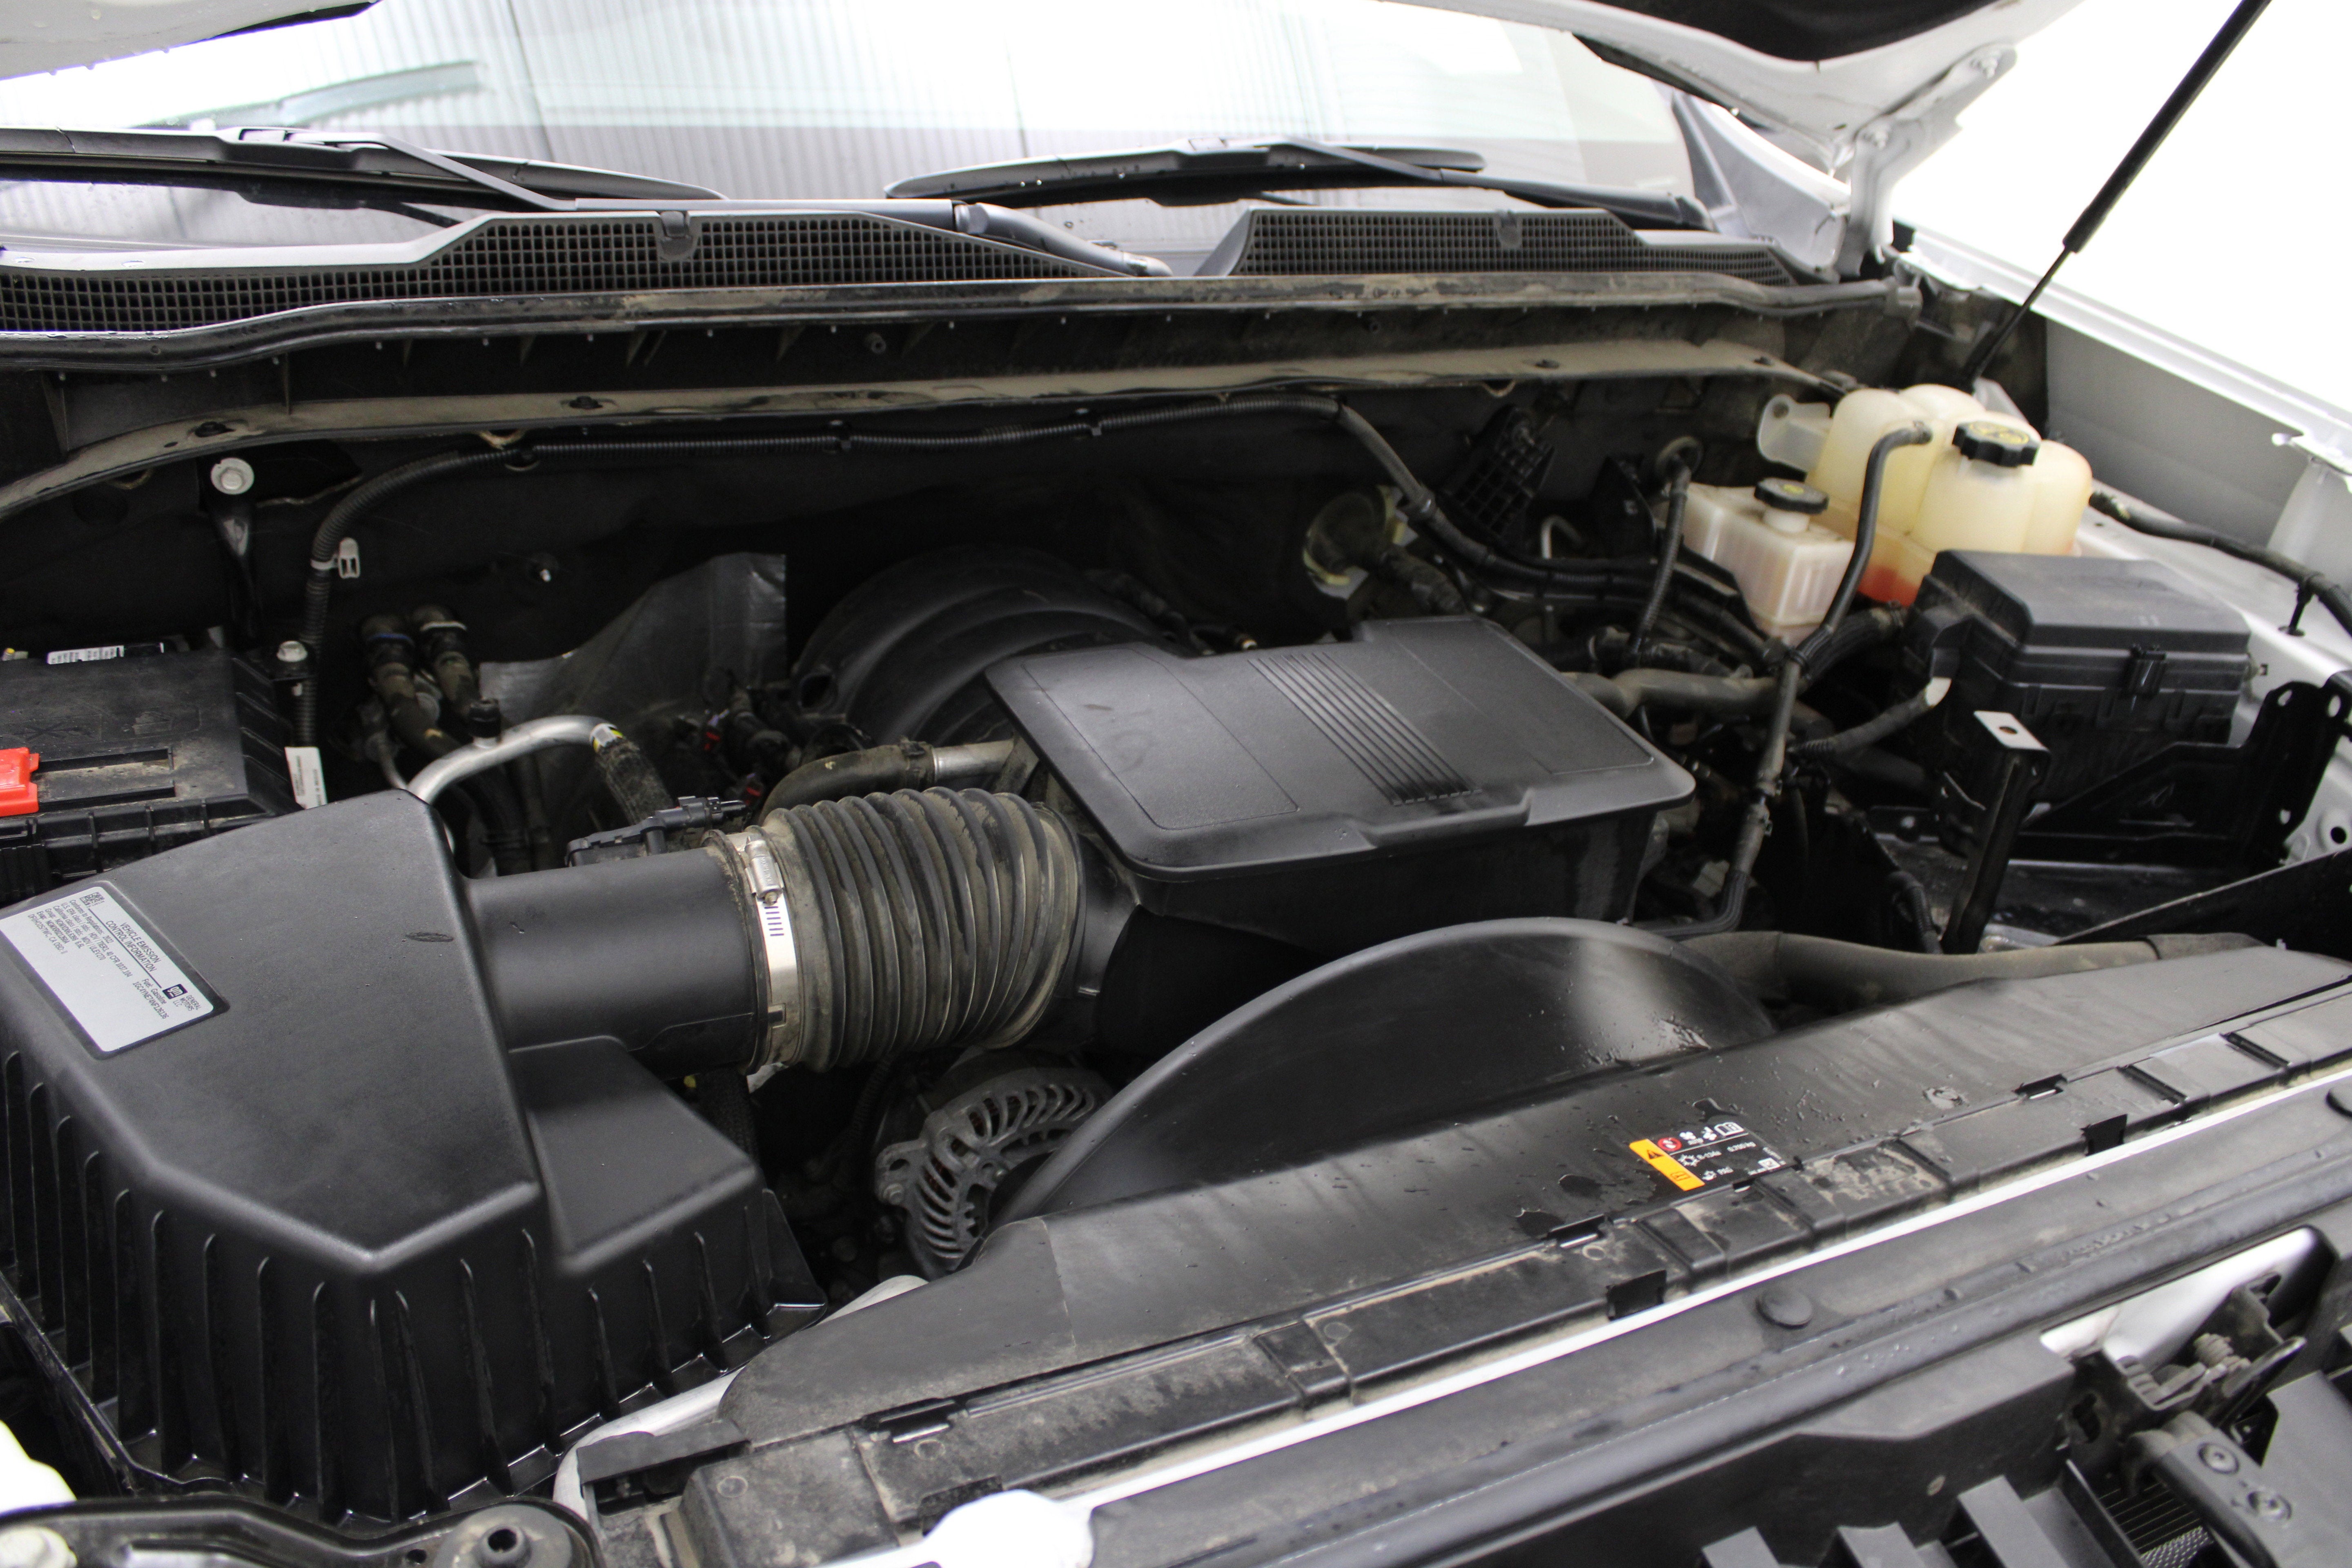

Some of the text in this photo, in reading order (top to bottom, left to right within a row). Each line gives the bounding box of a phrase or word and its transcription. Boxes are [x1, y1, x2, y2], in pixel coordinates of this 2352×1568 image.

[45, 908, 56, 918] Group:
[53, 905, 69, 919] California
[66, 918, 76, 927] class
[90, 945, 106, 960] ULEV270
[70, 900, 85, 913] Conforms
[86, 916, 105, 934] Regulations:
[103, 935, 113, 943] 2022
[73, 914, 83, 923] class
[110, 955, 119, 963] CFR
[116, 962, 132, 977] 1037.104
[106, 920, 156, 971] CONTROL INFORMATION
[120, 922, 160, 963] VEHICLE EMISSION
[143, 978, 168, 1004] Fuel: Gasoline
[180, 997, 194, 1011] MOTORS
[186, 995, 202, 1010] GENERAL
